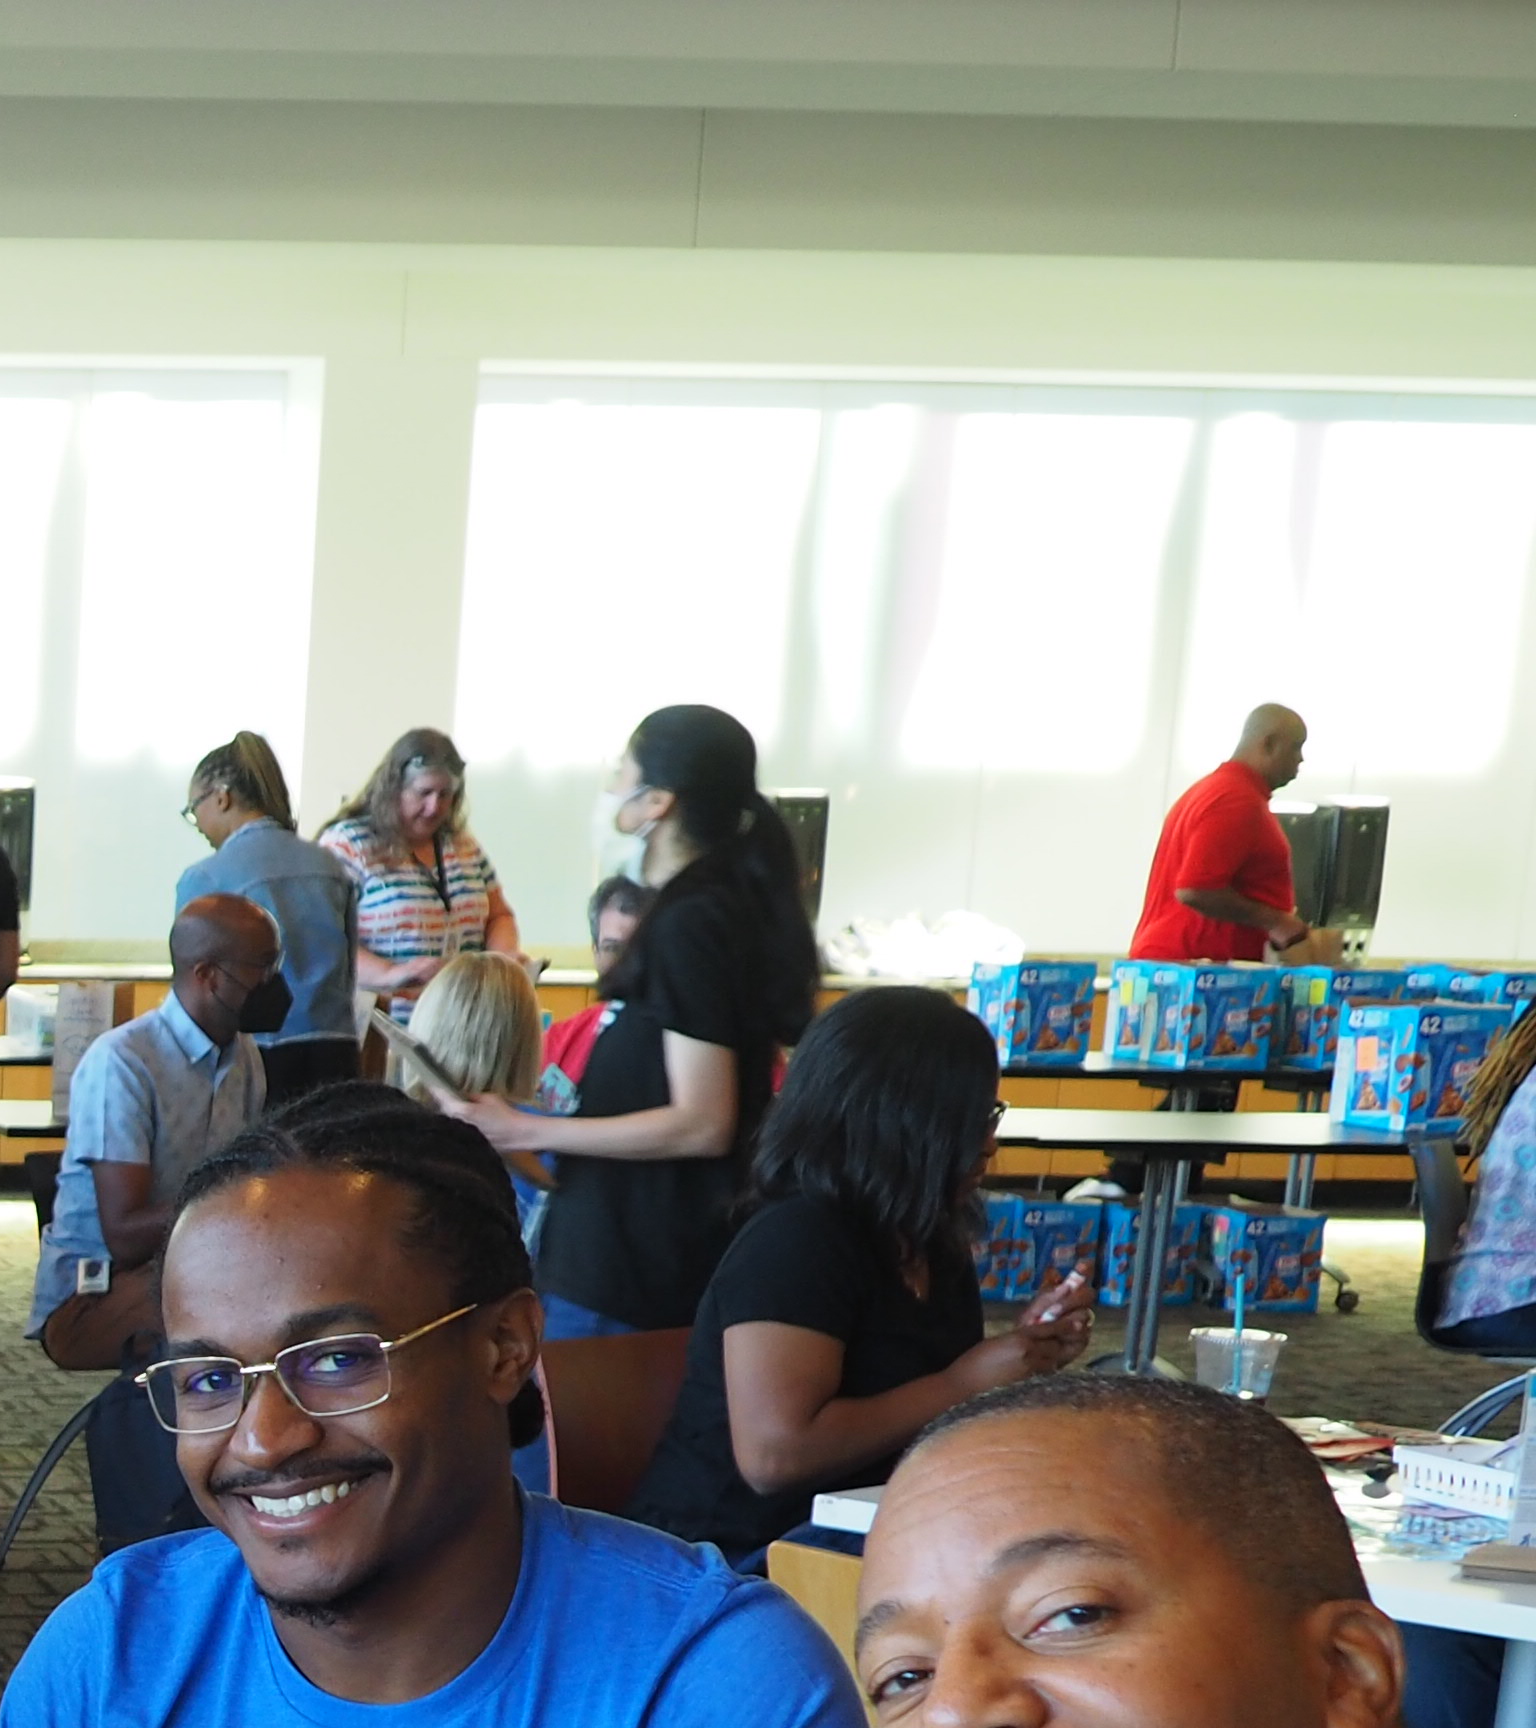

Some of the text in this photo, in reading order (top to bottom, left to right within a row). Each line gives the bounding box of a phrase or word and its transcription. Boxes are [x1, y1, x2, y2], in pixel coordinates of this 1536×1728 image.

[1196, 973, 1215, 988] 42
[1333, 975, 1351, 991] 42
[1349, 1009, 1365, 1027] 42
[1420, 1016, 1441, 1034] 42
